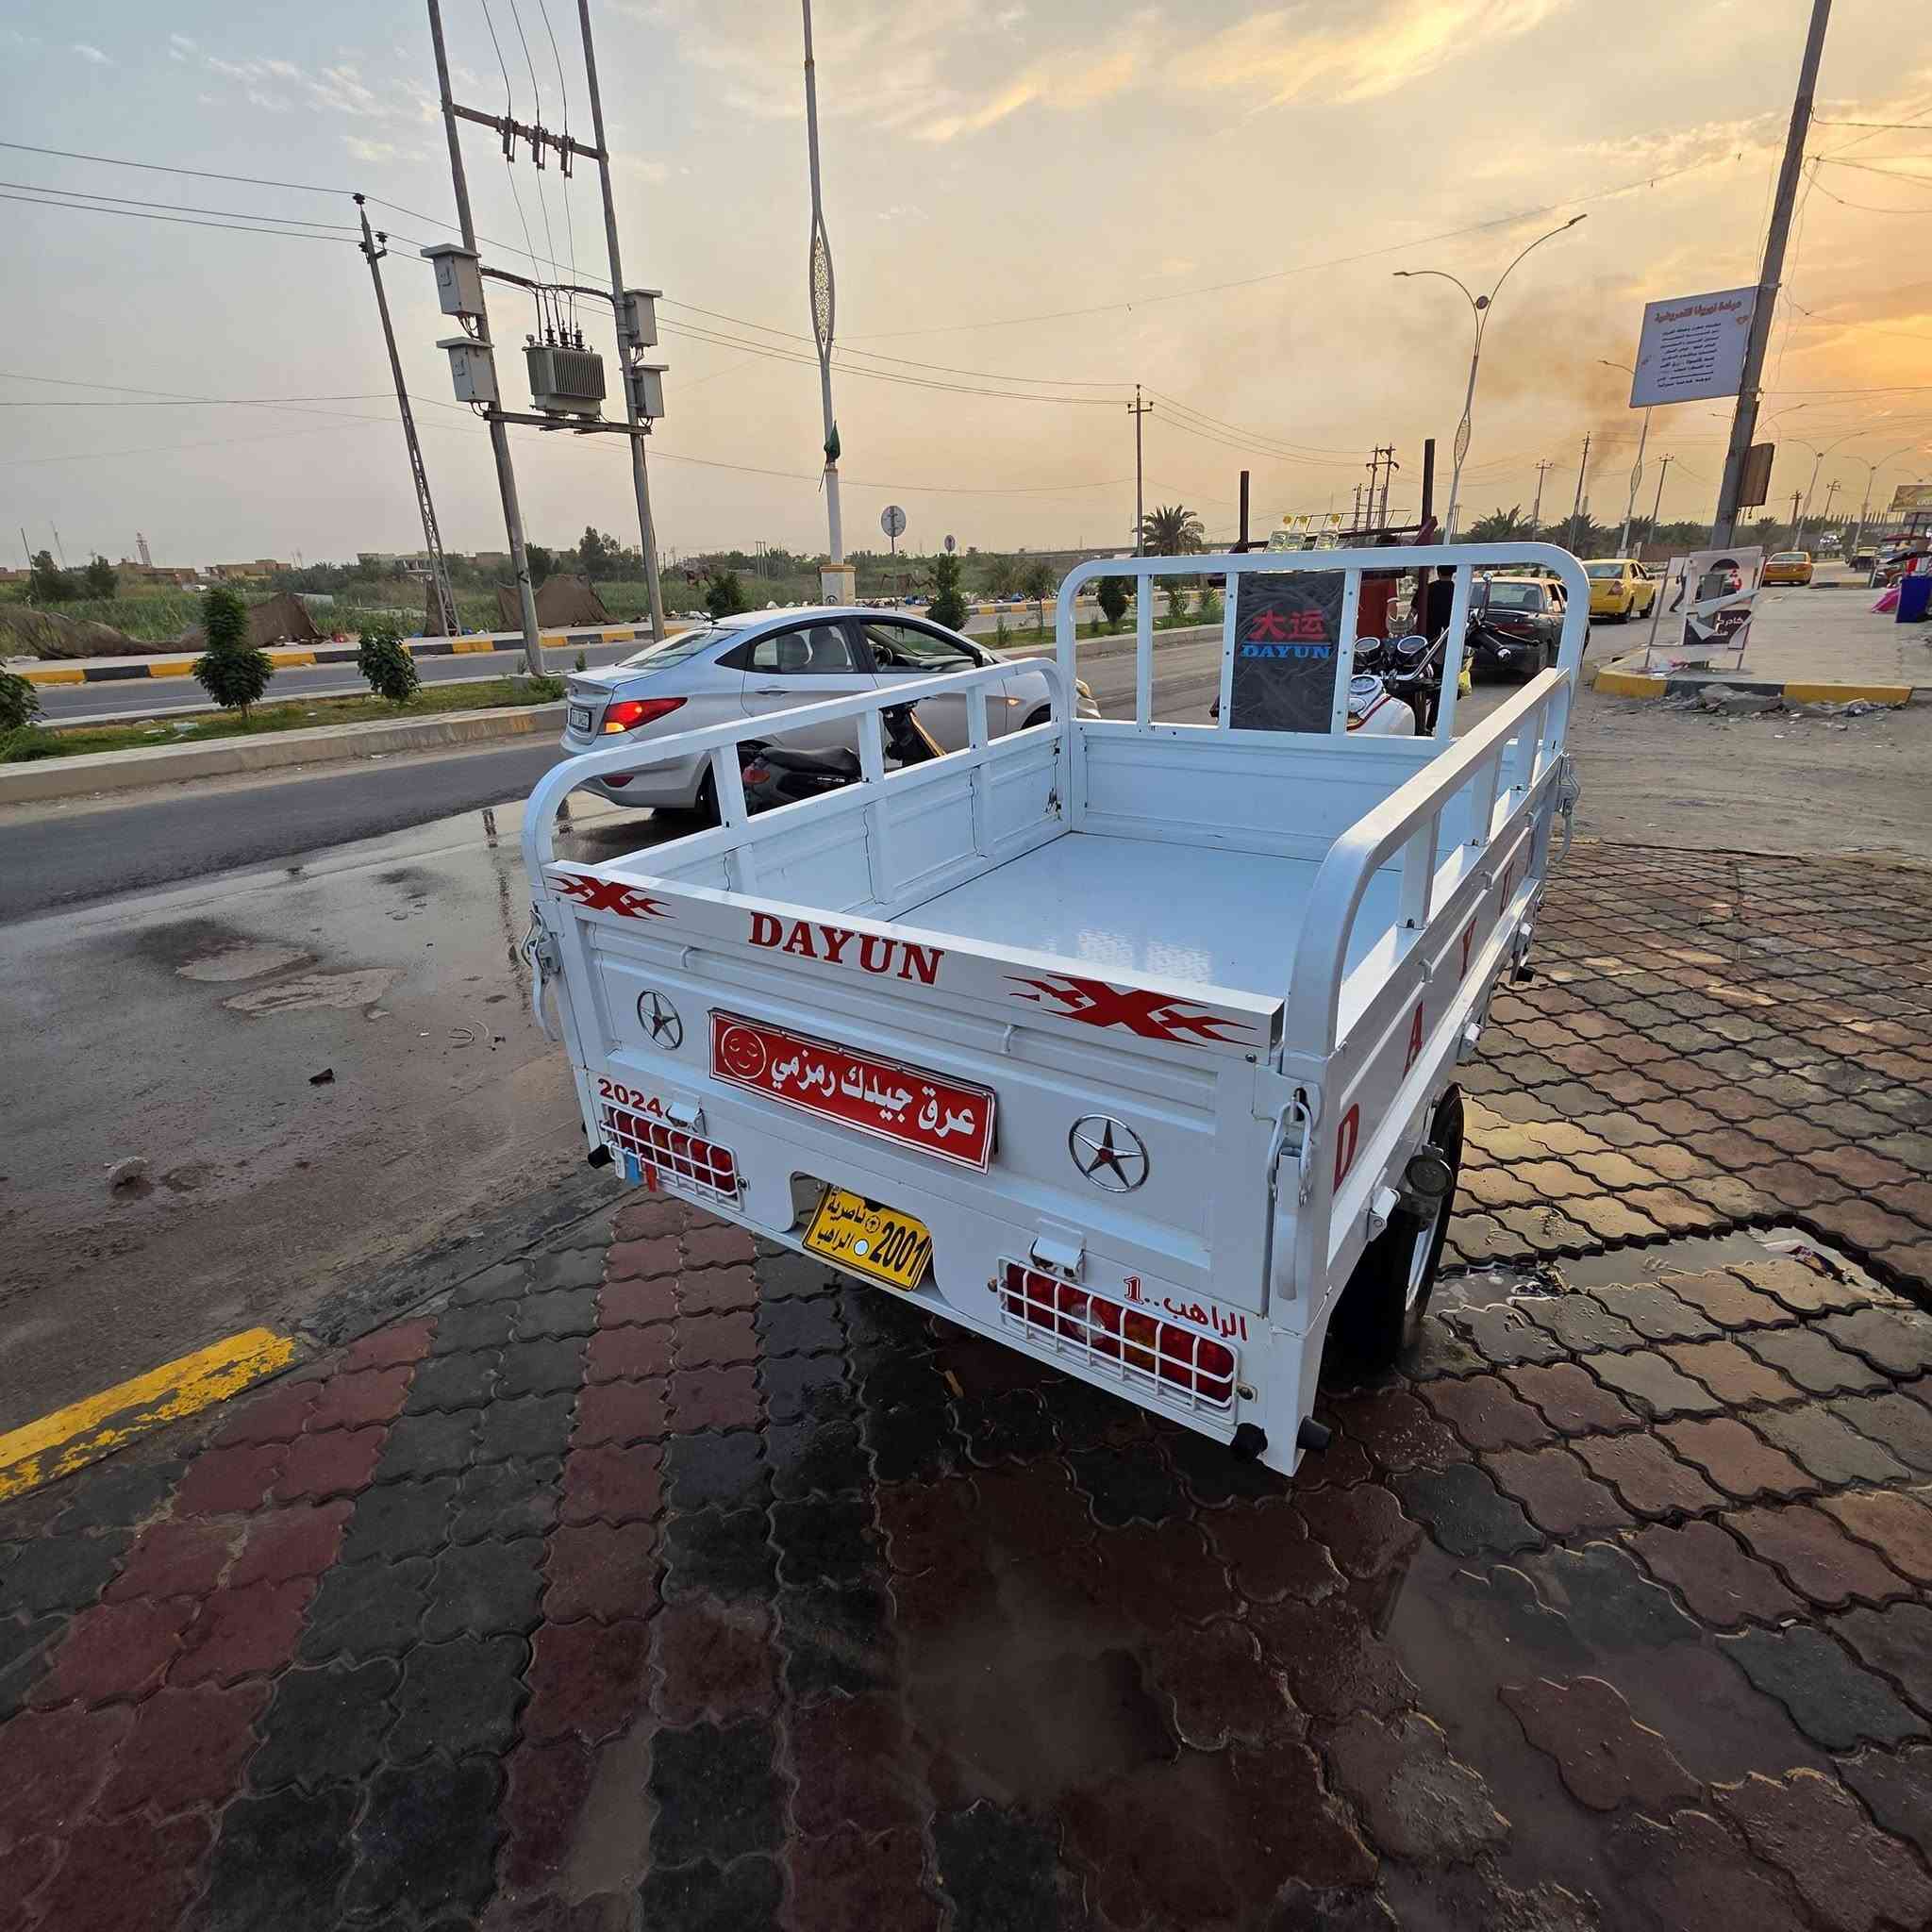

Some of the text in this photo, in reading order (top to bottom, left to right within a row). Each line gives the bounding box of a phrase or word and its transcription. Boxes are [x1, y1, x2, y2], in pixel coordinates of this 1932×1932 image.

[1247, 609, 1328, 641] 大运
[1241, 645, 1329, 658] DAYUN
[748, 911, 944, 985] DAYUN
[598, 1078, 663, 1119] 2024
[918, 1086, 975, 1138] عرق
[869, 1221, 931, 1278] 2001
